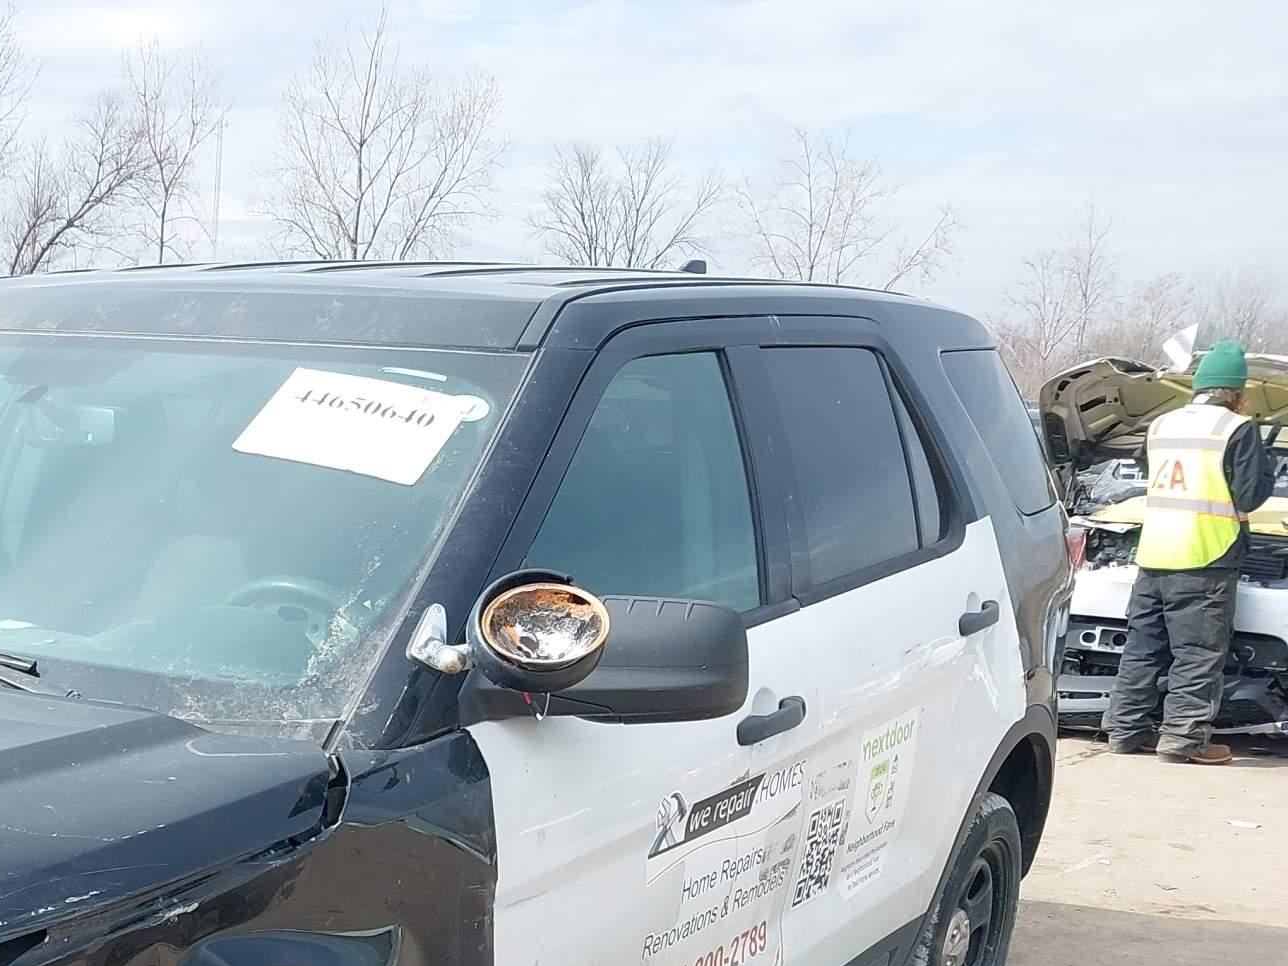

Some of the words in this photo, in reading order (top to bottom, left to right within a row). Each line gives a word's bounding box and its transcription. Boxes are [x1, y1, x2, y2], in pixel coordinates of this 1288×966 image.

[295, 389, 436, 429] 44650640
[863, 720, 915, 762] nextdoor
[689, 806, 711, 833] we
[713, 783, 756, 822] repair
[681, 870, 717, 904] Home
[720, 848, 763, 884] Repairs
[641, 906, 718, 960] Renovations
[720, 895, 729, 919] &
[732, 870, 784, 912] Remodels
